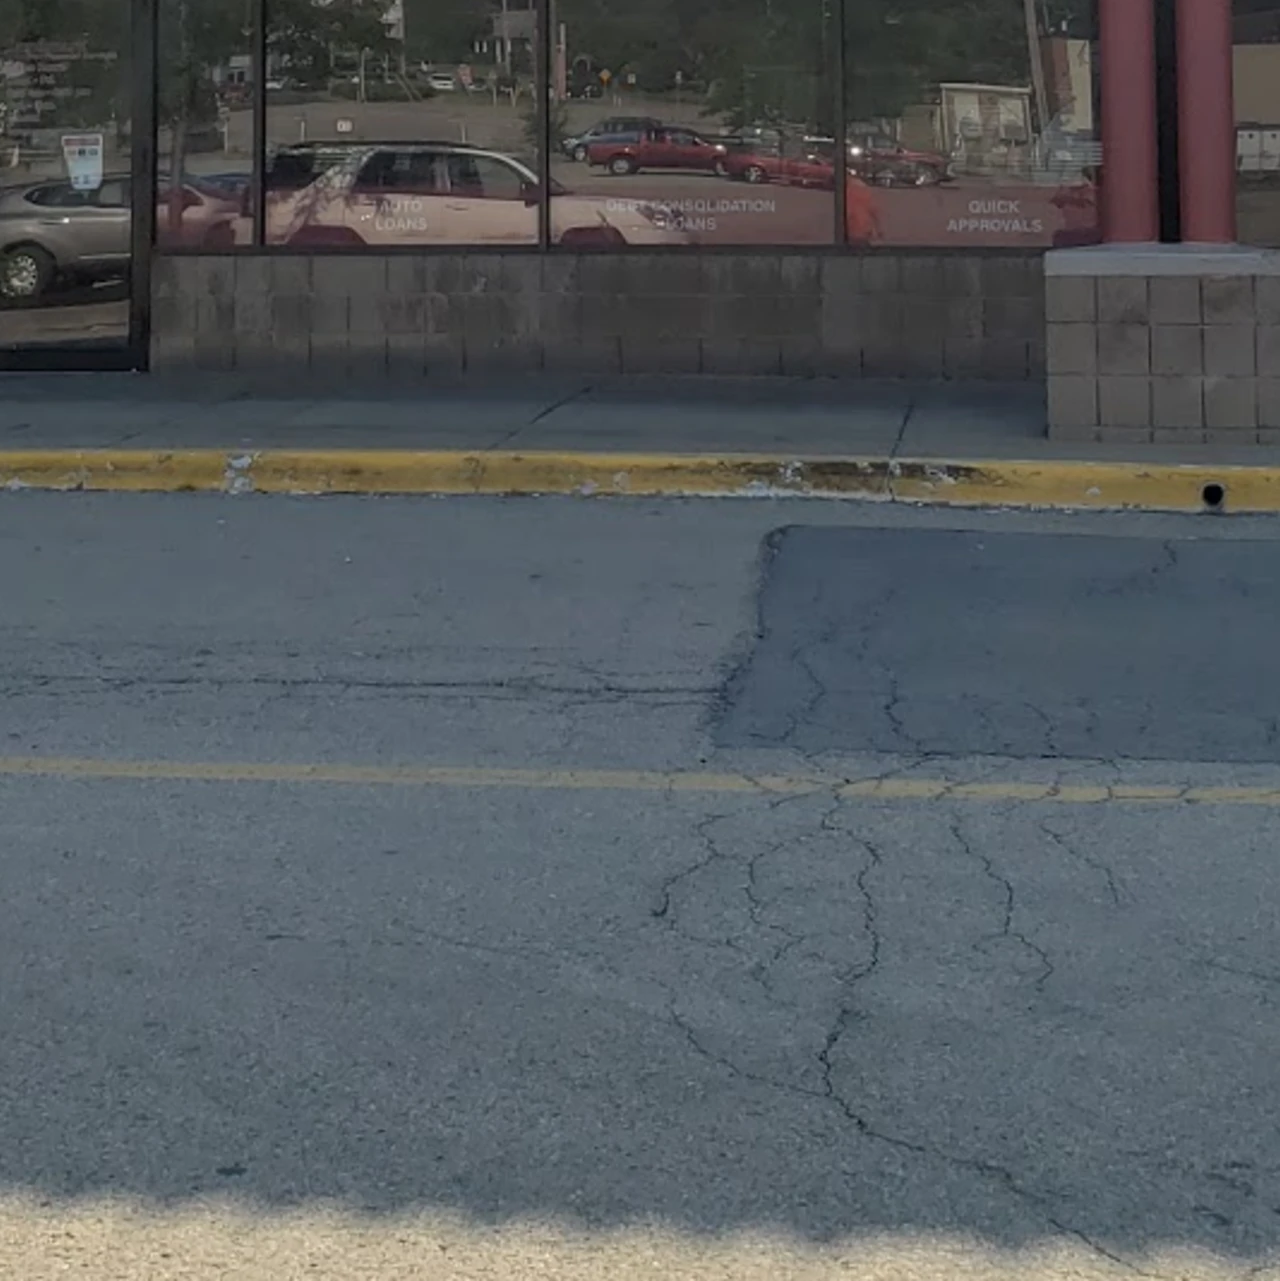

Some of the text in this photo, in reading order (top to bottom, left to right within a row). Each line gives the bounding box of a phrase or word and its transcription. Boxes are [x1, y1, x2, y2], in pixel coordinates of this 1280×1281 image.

[380, 200, 423, 213] AUTO
[968, 200, 1021, 214] QUICK
[375, 217, 428, 231] LOANS
[666, 217, 717, 231] LOANS
[946, 219, 1043, 233] APPROVALS
